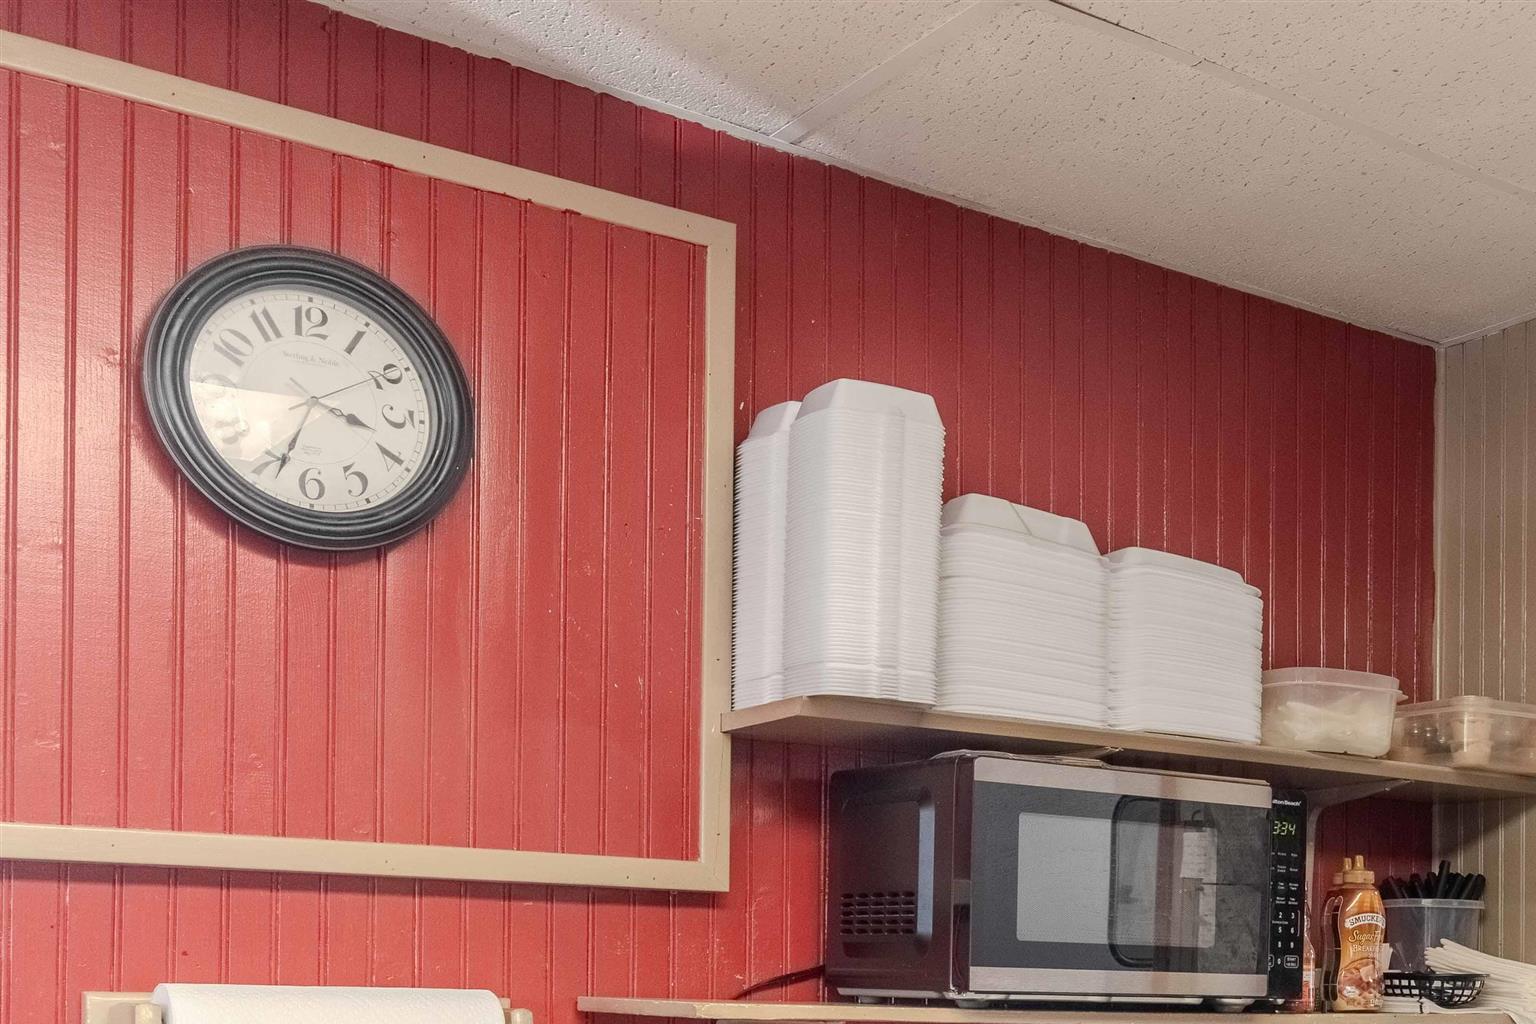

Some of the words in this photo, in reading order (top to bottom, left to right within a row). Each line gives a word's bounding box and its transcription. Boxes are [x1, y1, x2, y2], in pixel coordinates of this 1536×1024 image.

[293, 304, 330, 341] 12
[213, 328, 255, 368] 10
[344, 330, 367, 355] 1
[368, 363, 403, 391] 2
[381, 403, 416, 430] 3
[375, 441, 405, 472] 4
[298, 467, 326, 500] 6
[343, 462, 369, 498] 5
